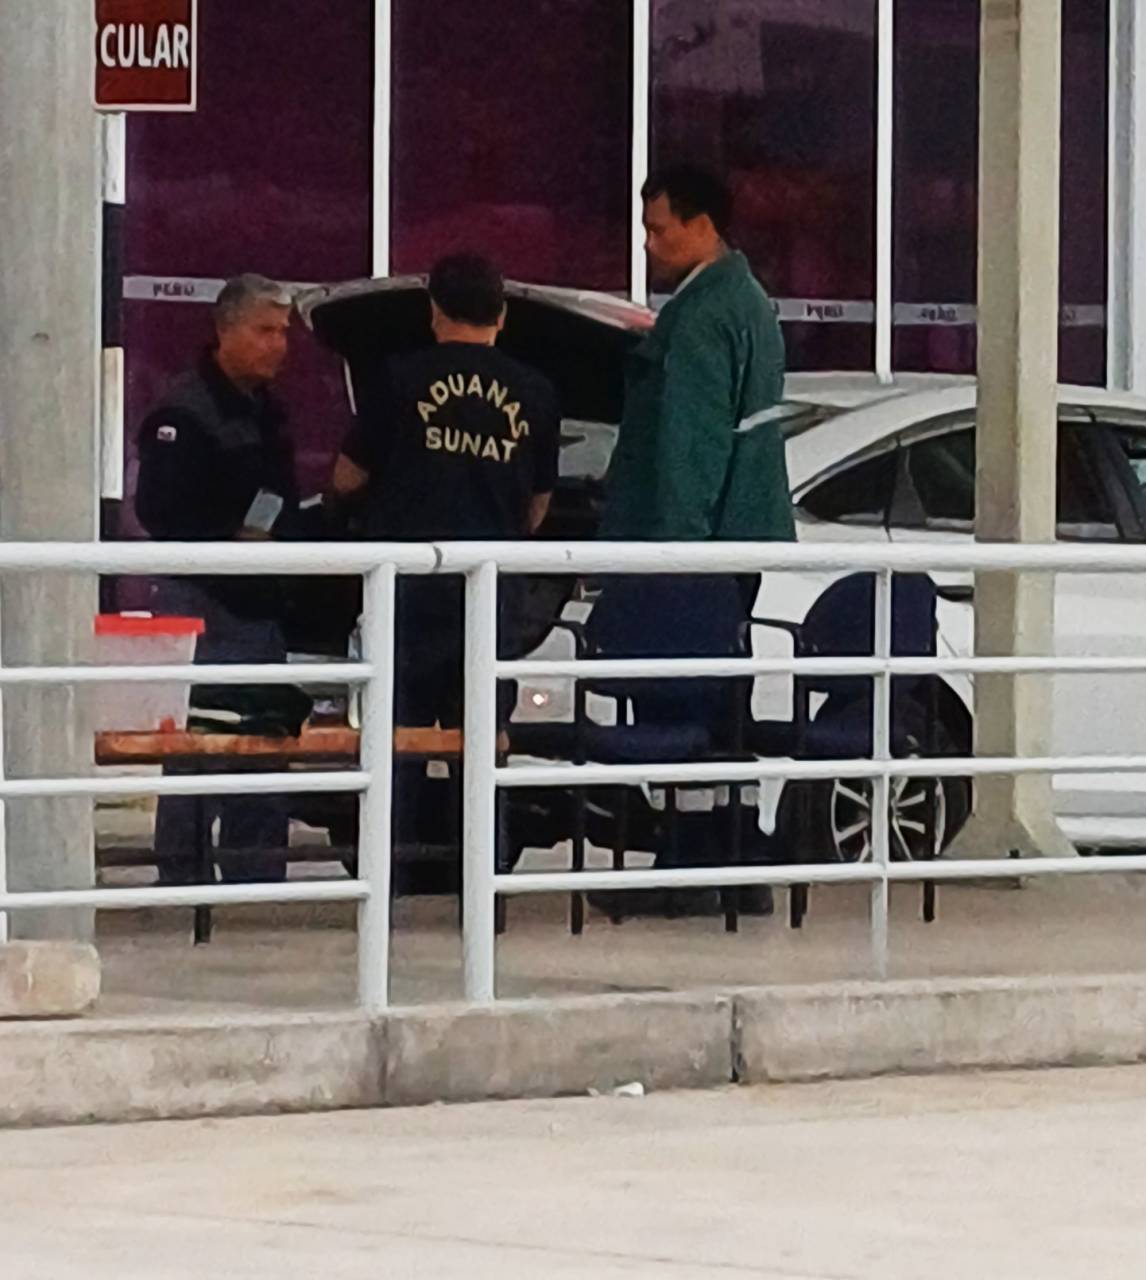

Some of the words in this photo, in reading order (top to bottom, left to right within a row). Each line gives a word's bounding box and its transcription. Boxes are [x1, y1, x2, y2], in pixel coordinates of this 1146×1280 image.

[97, 23, 189, 69] CULAR
[417, 373, 530, 439] ADUANAS
[425, 426, 518, 464] SUNAT
